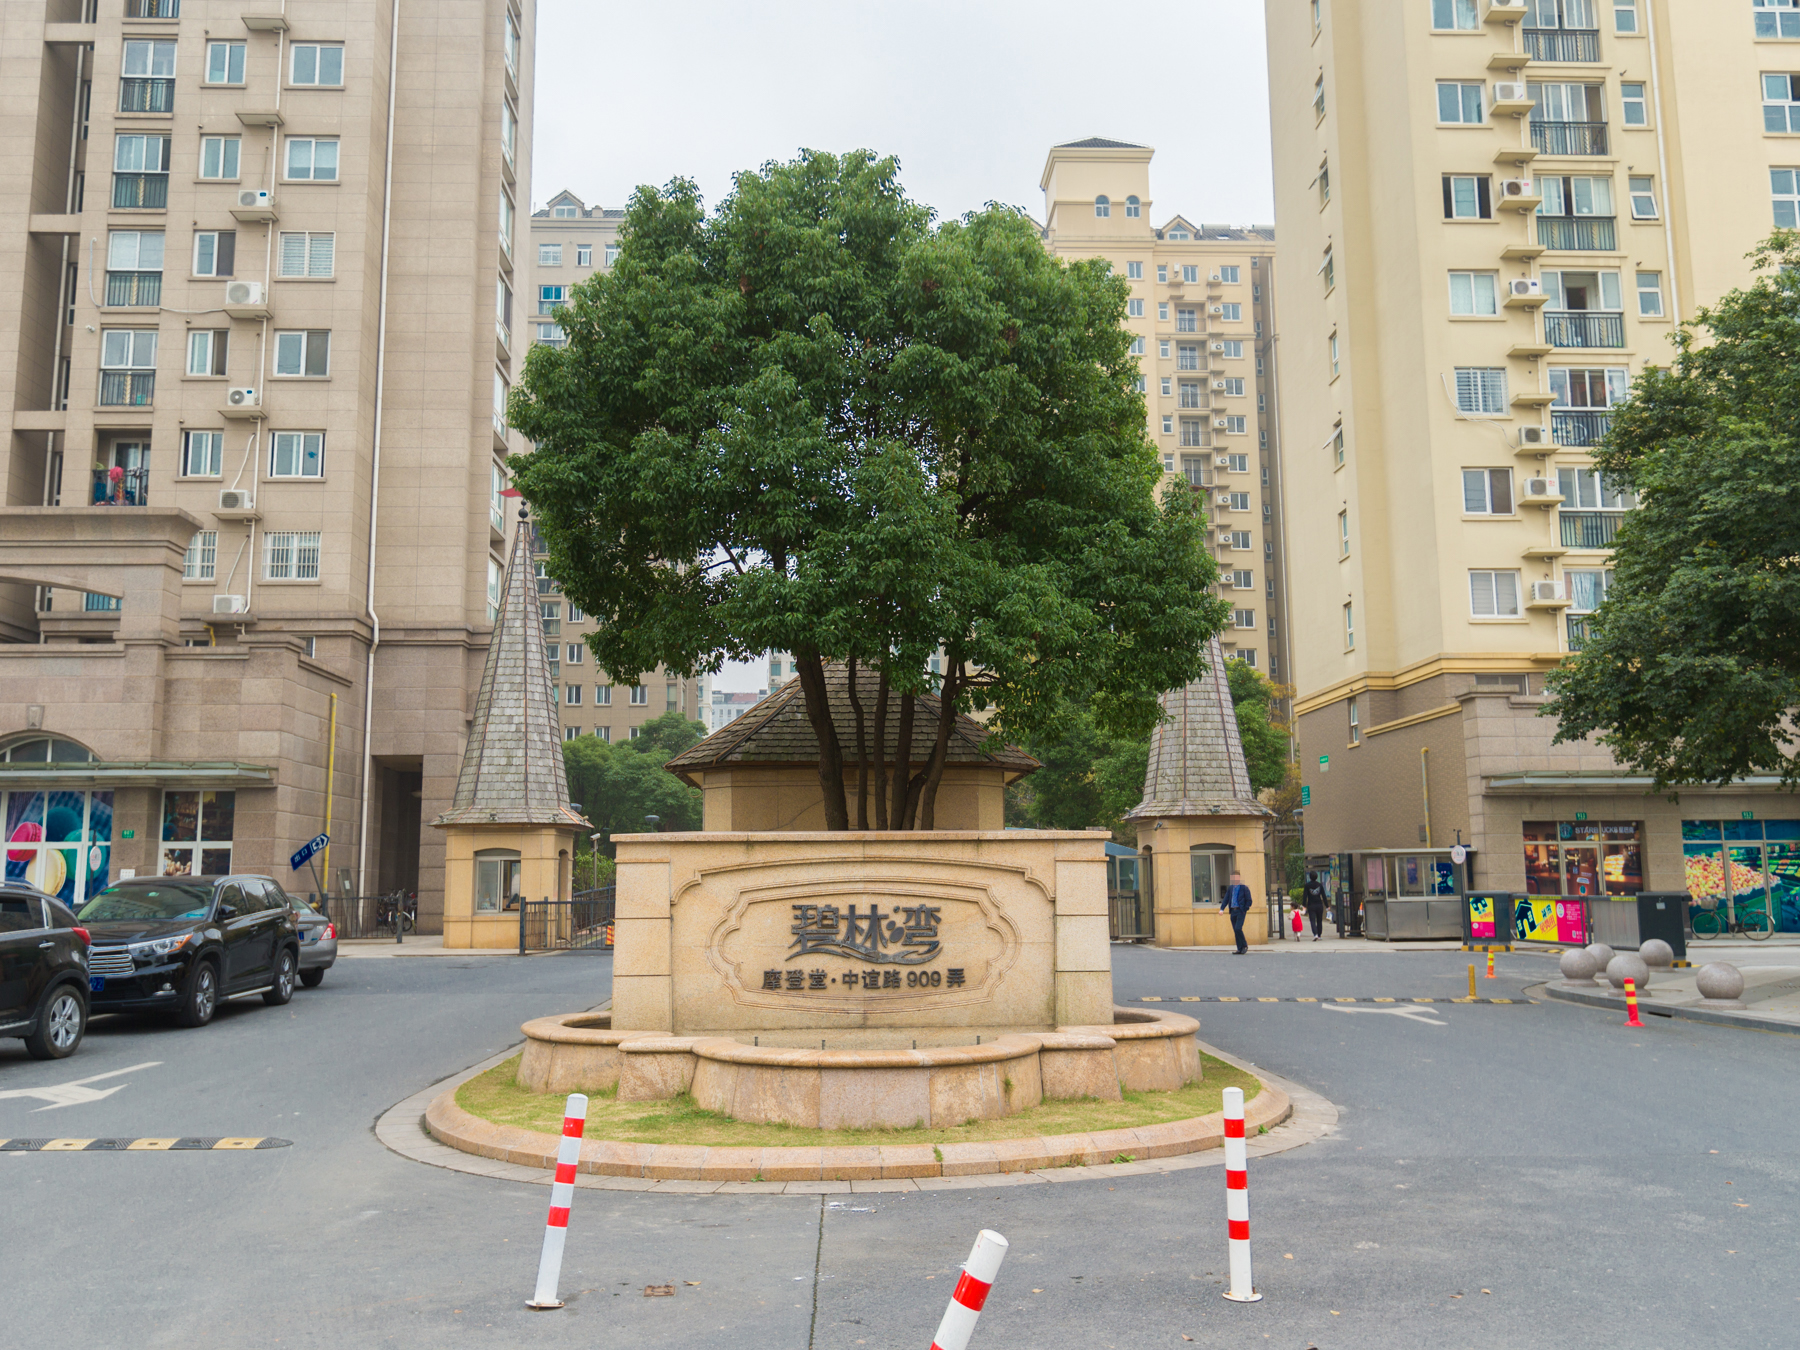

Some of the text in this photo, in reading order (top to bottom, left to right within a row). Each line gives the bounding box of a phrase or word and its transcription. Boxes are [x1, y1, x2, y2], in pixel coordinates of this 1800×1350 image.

[294, 848, 308, 863] 出口
[785, 904, 943, 965] 碧林湾
